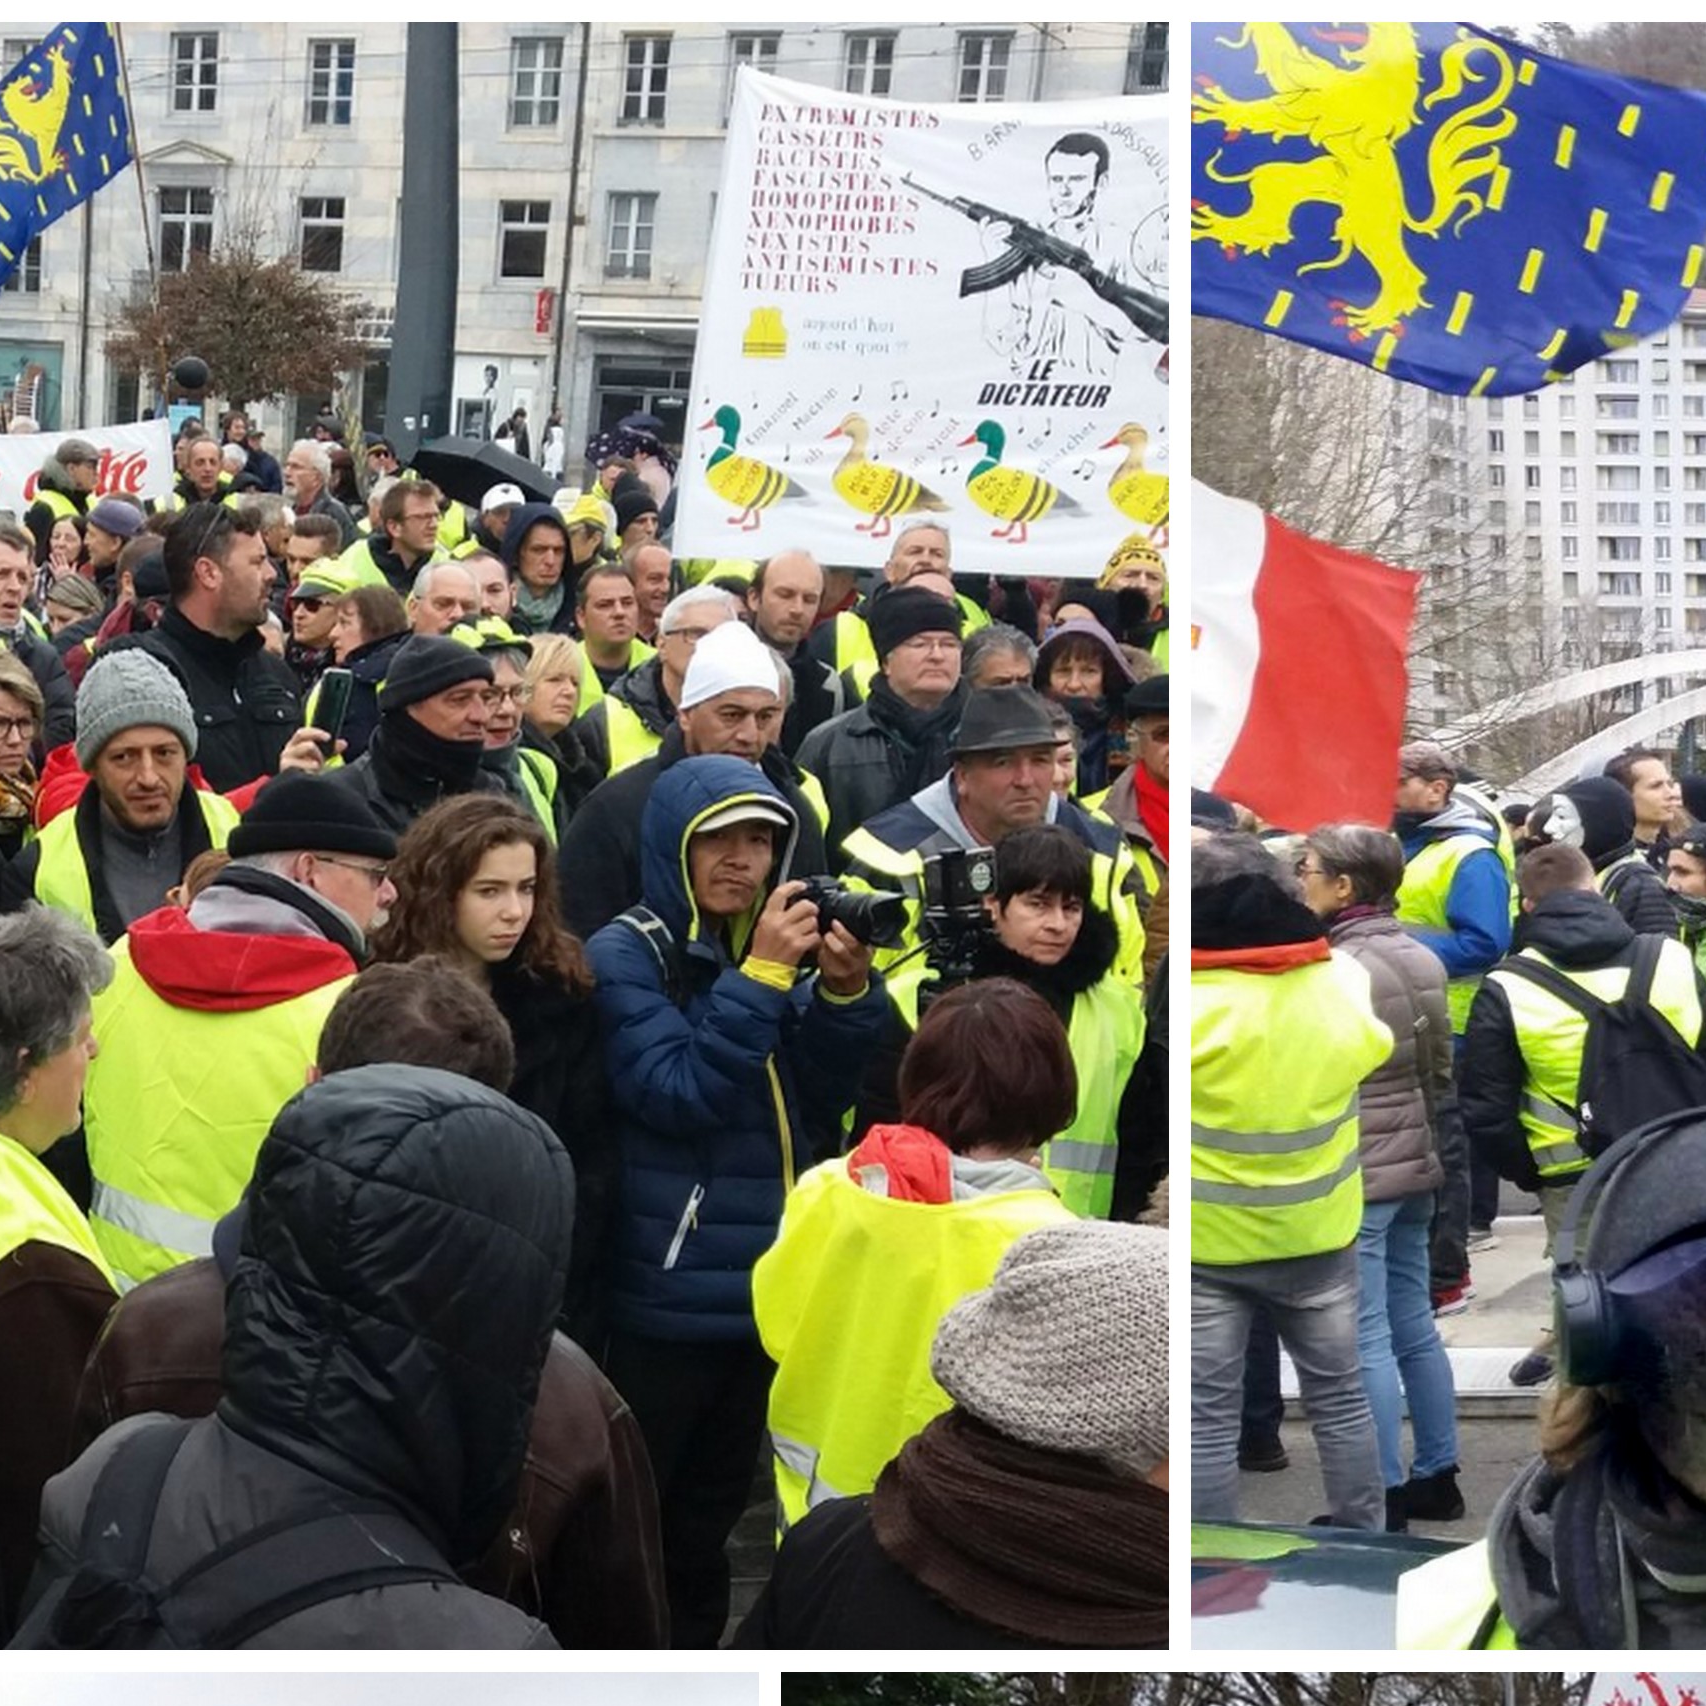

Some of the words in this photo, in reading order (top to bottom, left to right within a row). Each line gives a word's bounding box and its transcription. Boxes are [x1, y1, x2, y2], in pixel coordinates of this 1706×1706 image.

[761, 104, 939, 128] EXTREMISTES
[758, 128, 884, 149] CASSEURS
[756, 148, 881, 170] RACISTES
[754, 169, 892, 191] FASCISTES
[751, 190, 919, 212] HOMOPHOBES
[750, 211, 916, 234] XENOPHOBES
[746, 233, 870, 252] SEXISTES
[744, 253, 938, 275] ANTISEMISTES
[741, 273, 838, 293] TUEURS
[1028, 359, 1056, 381] LE
[977, 383, 1111, 408] DICTATEUR
